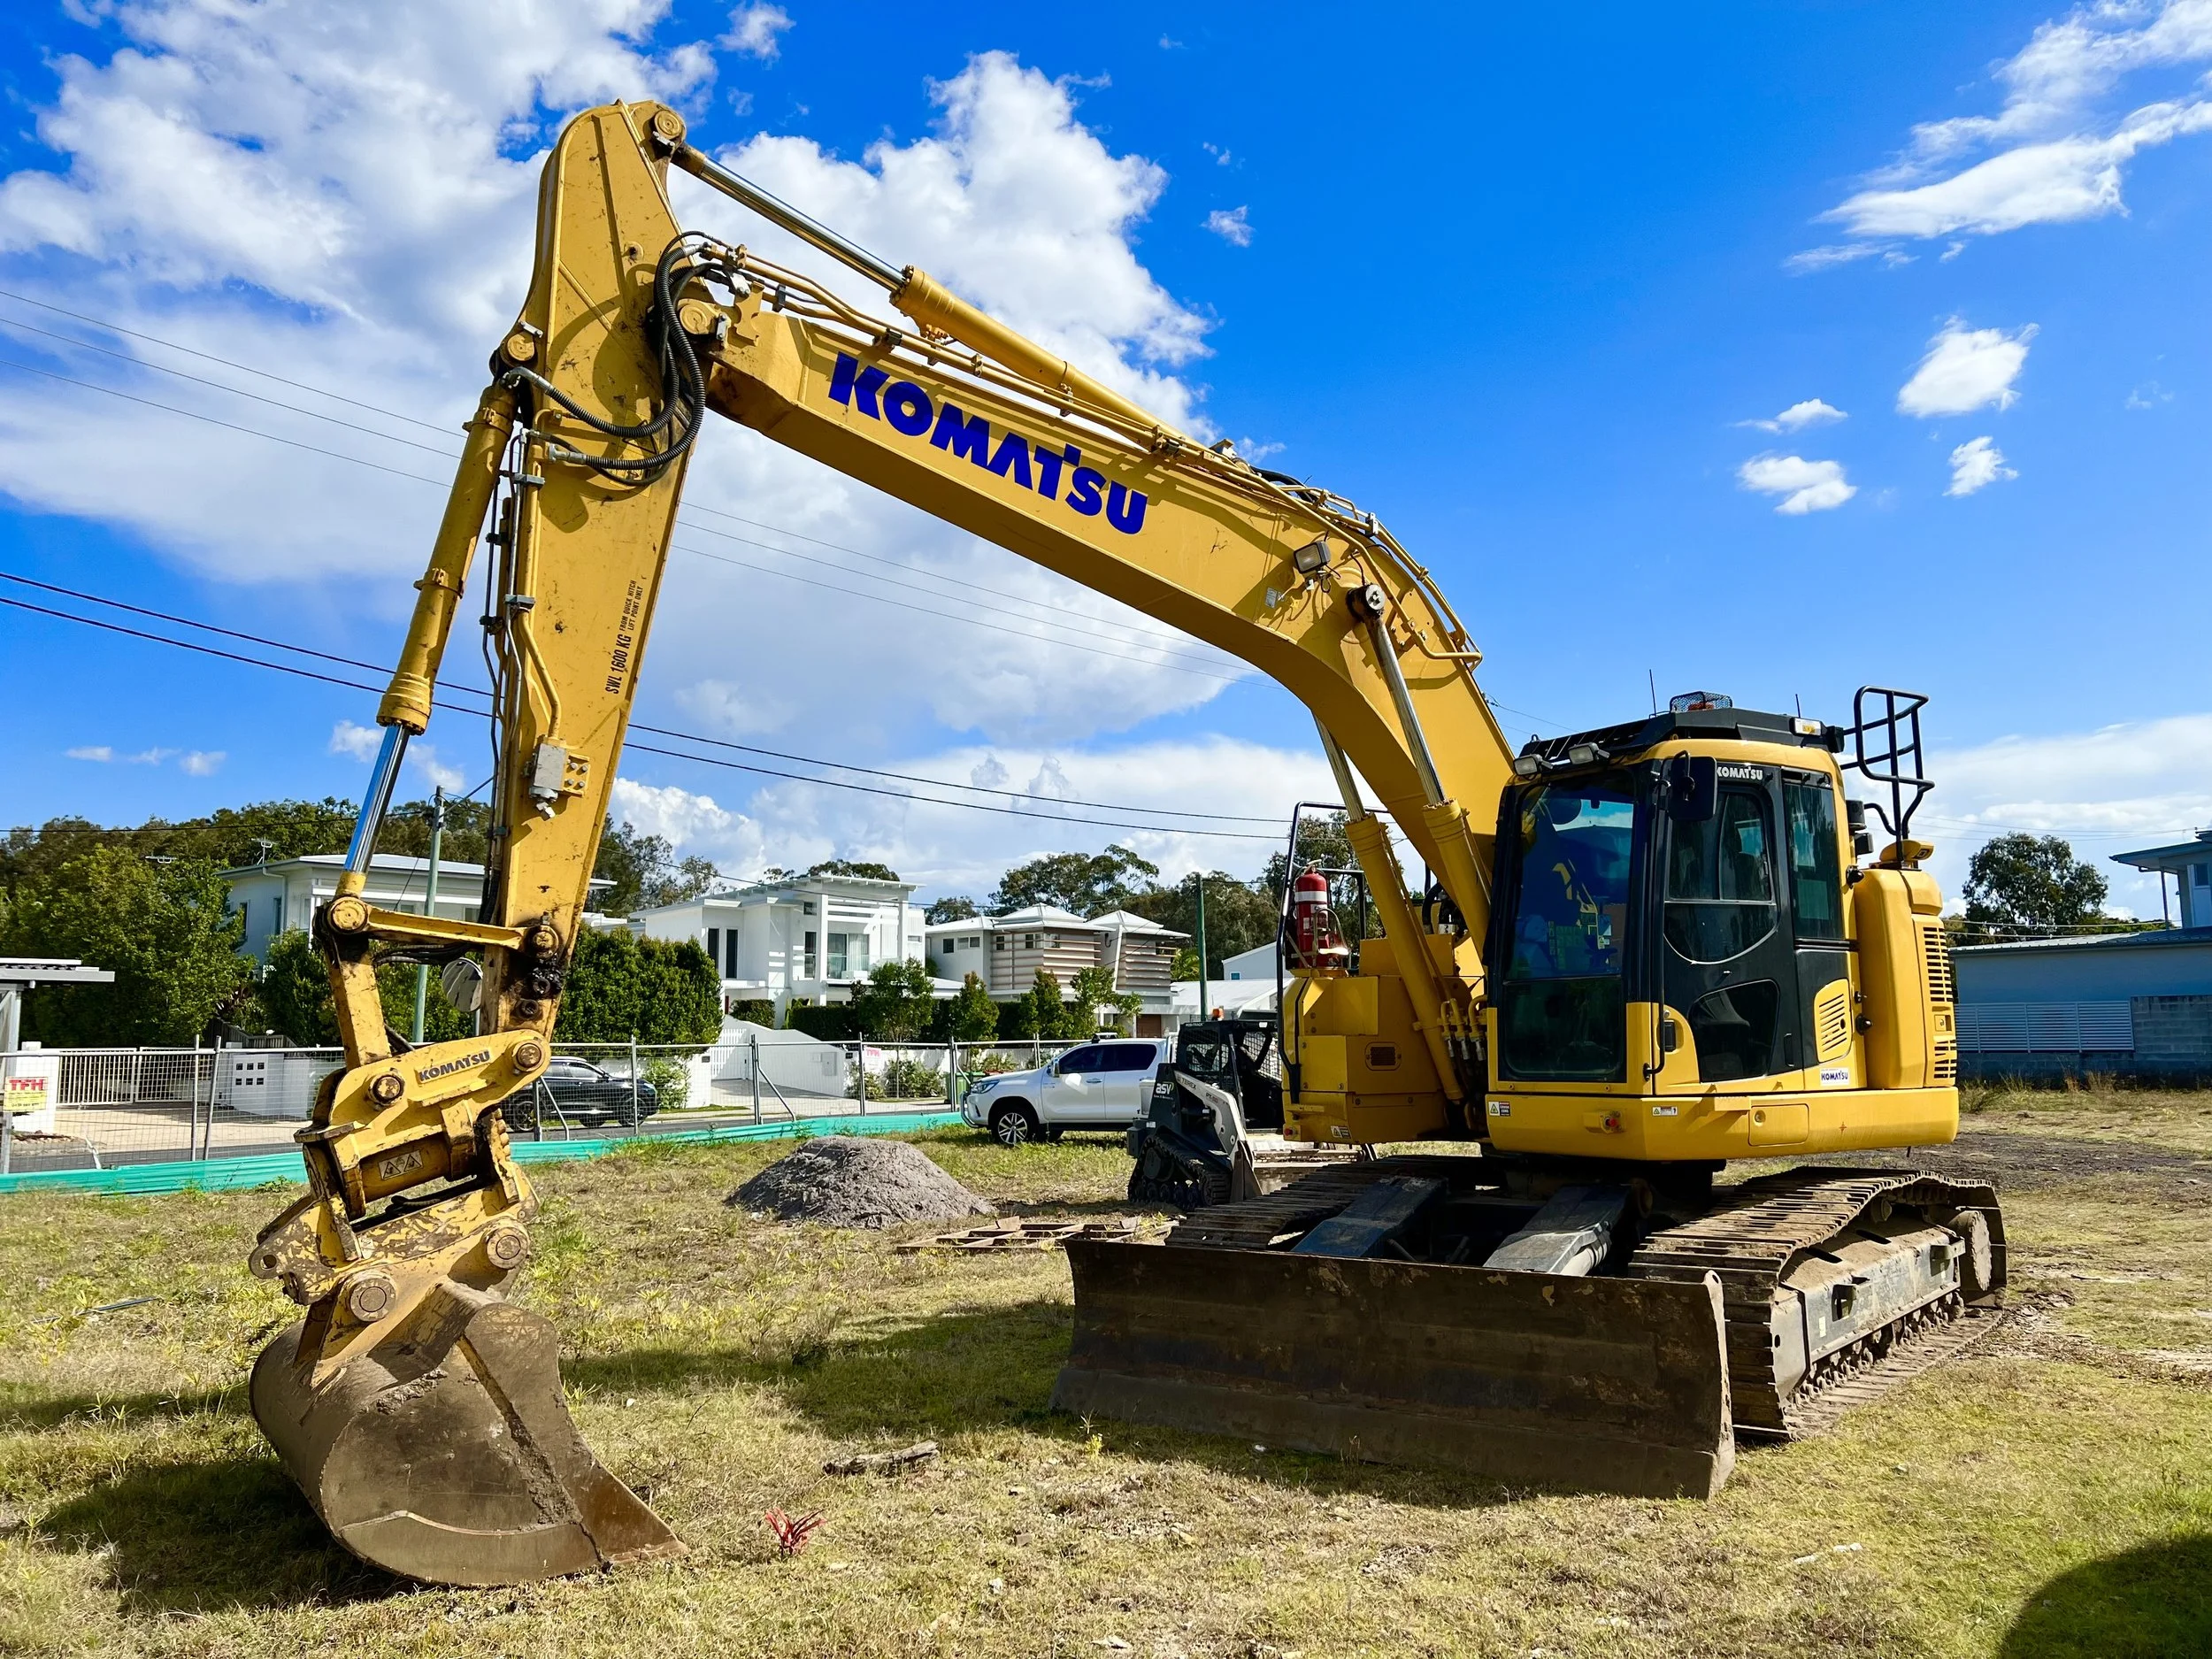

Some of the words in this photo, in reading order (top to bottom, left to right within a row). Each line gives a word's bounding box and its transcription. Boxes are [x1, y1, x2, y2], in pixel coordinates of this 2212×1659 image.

[828, 351, 1148, 534] KOMATSU
[627, 580, 636, 596] HITCH
[623, 598, 633, 614] QUICK
[631, 602, 640, 618] POINT
[619, 616, 628, 631] FROM
[627, 619, 636, 631] LIFT
[616, 634, 632, 649] KG
[611, 649, 627, 672] 1600
[605, 675, 622, 695] SWL
[419, 1049, 490, 1081] KOMATSU
[1821, 1070, 1848, 1080] KOMATSU
[9, 1079, 43, 1091] TFH
